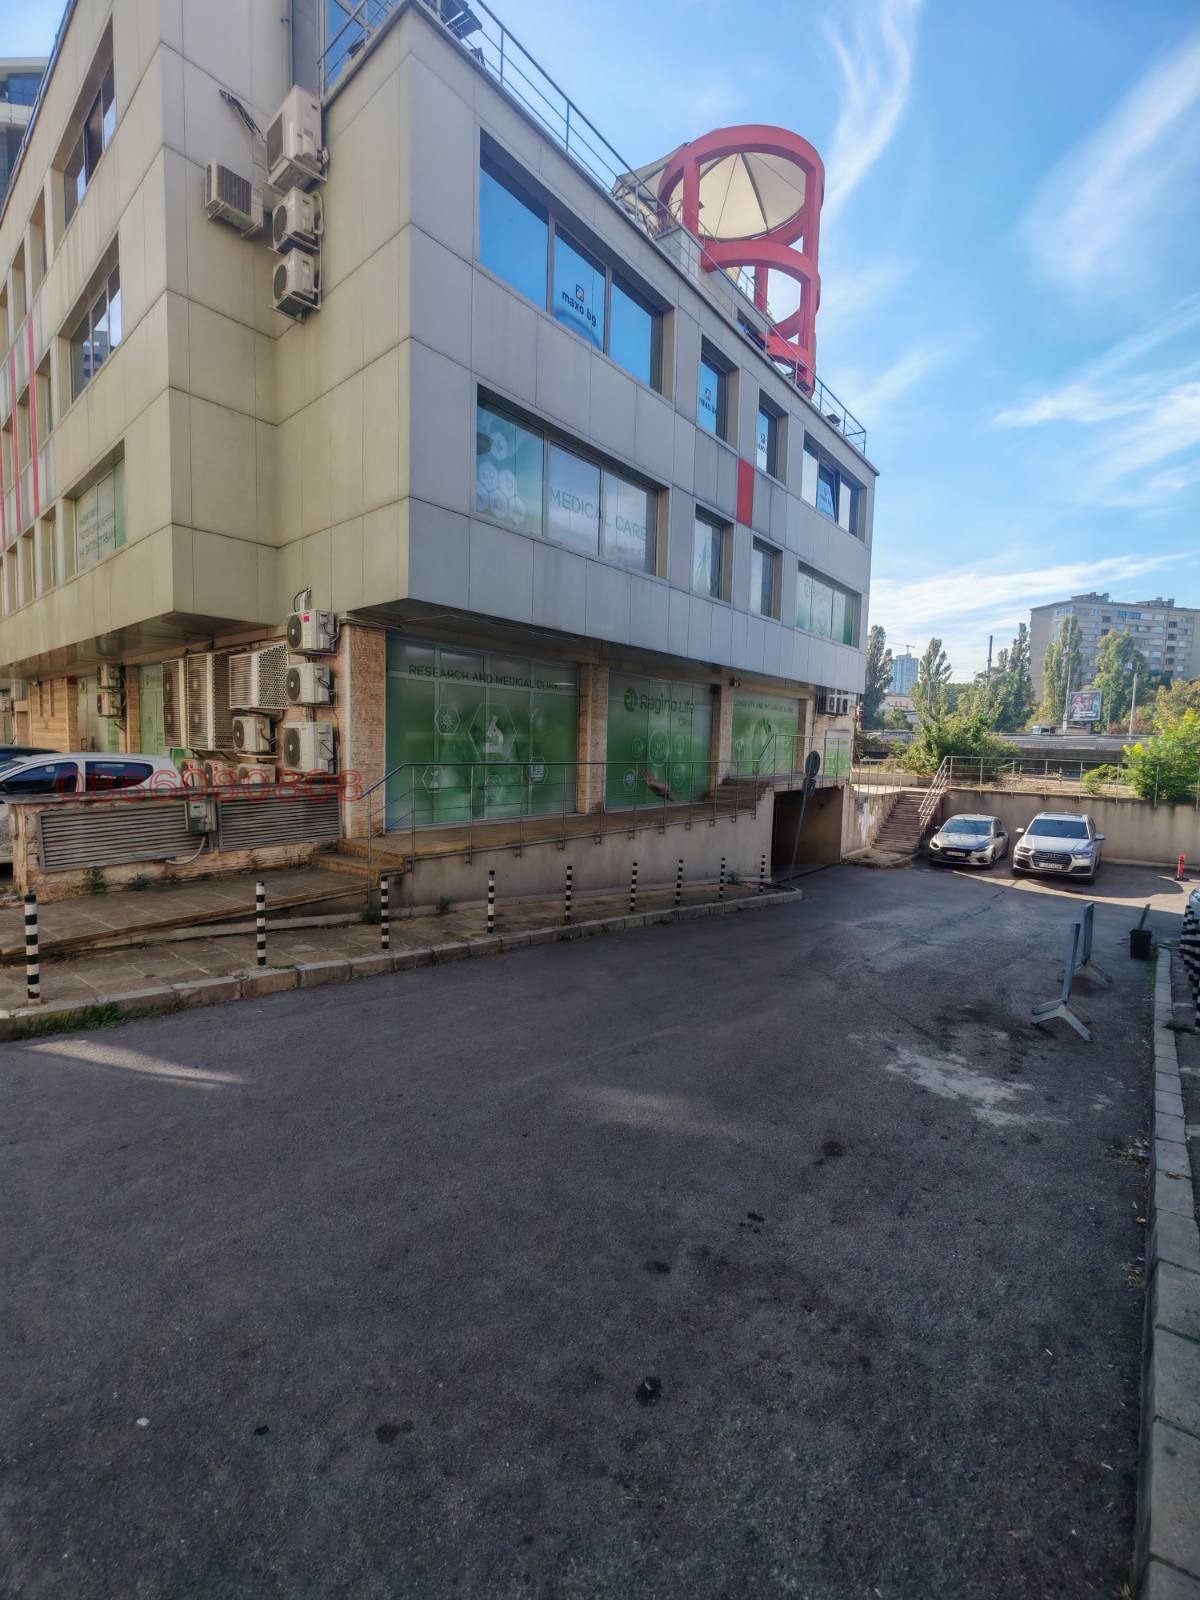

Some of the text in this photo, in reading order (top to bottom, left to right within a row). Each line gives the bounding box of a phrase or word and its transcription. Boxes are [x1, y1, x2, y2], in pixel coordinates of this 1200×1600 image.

[550, 488, 647, 541] MEDICAL CARE
[409, 664, 469, 680] RESEARCH
[472, 671, 494, 684] AND
[495, 673, 534, 689] MEDICAL
[640, 693, 695, 714] Regina Life
